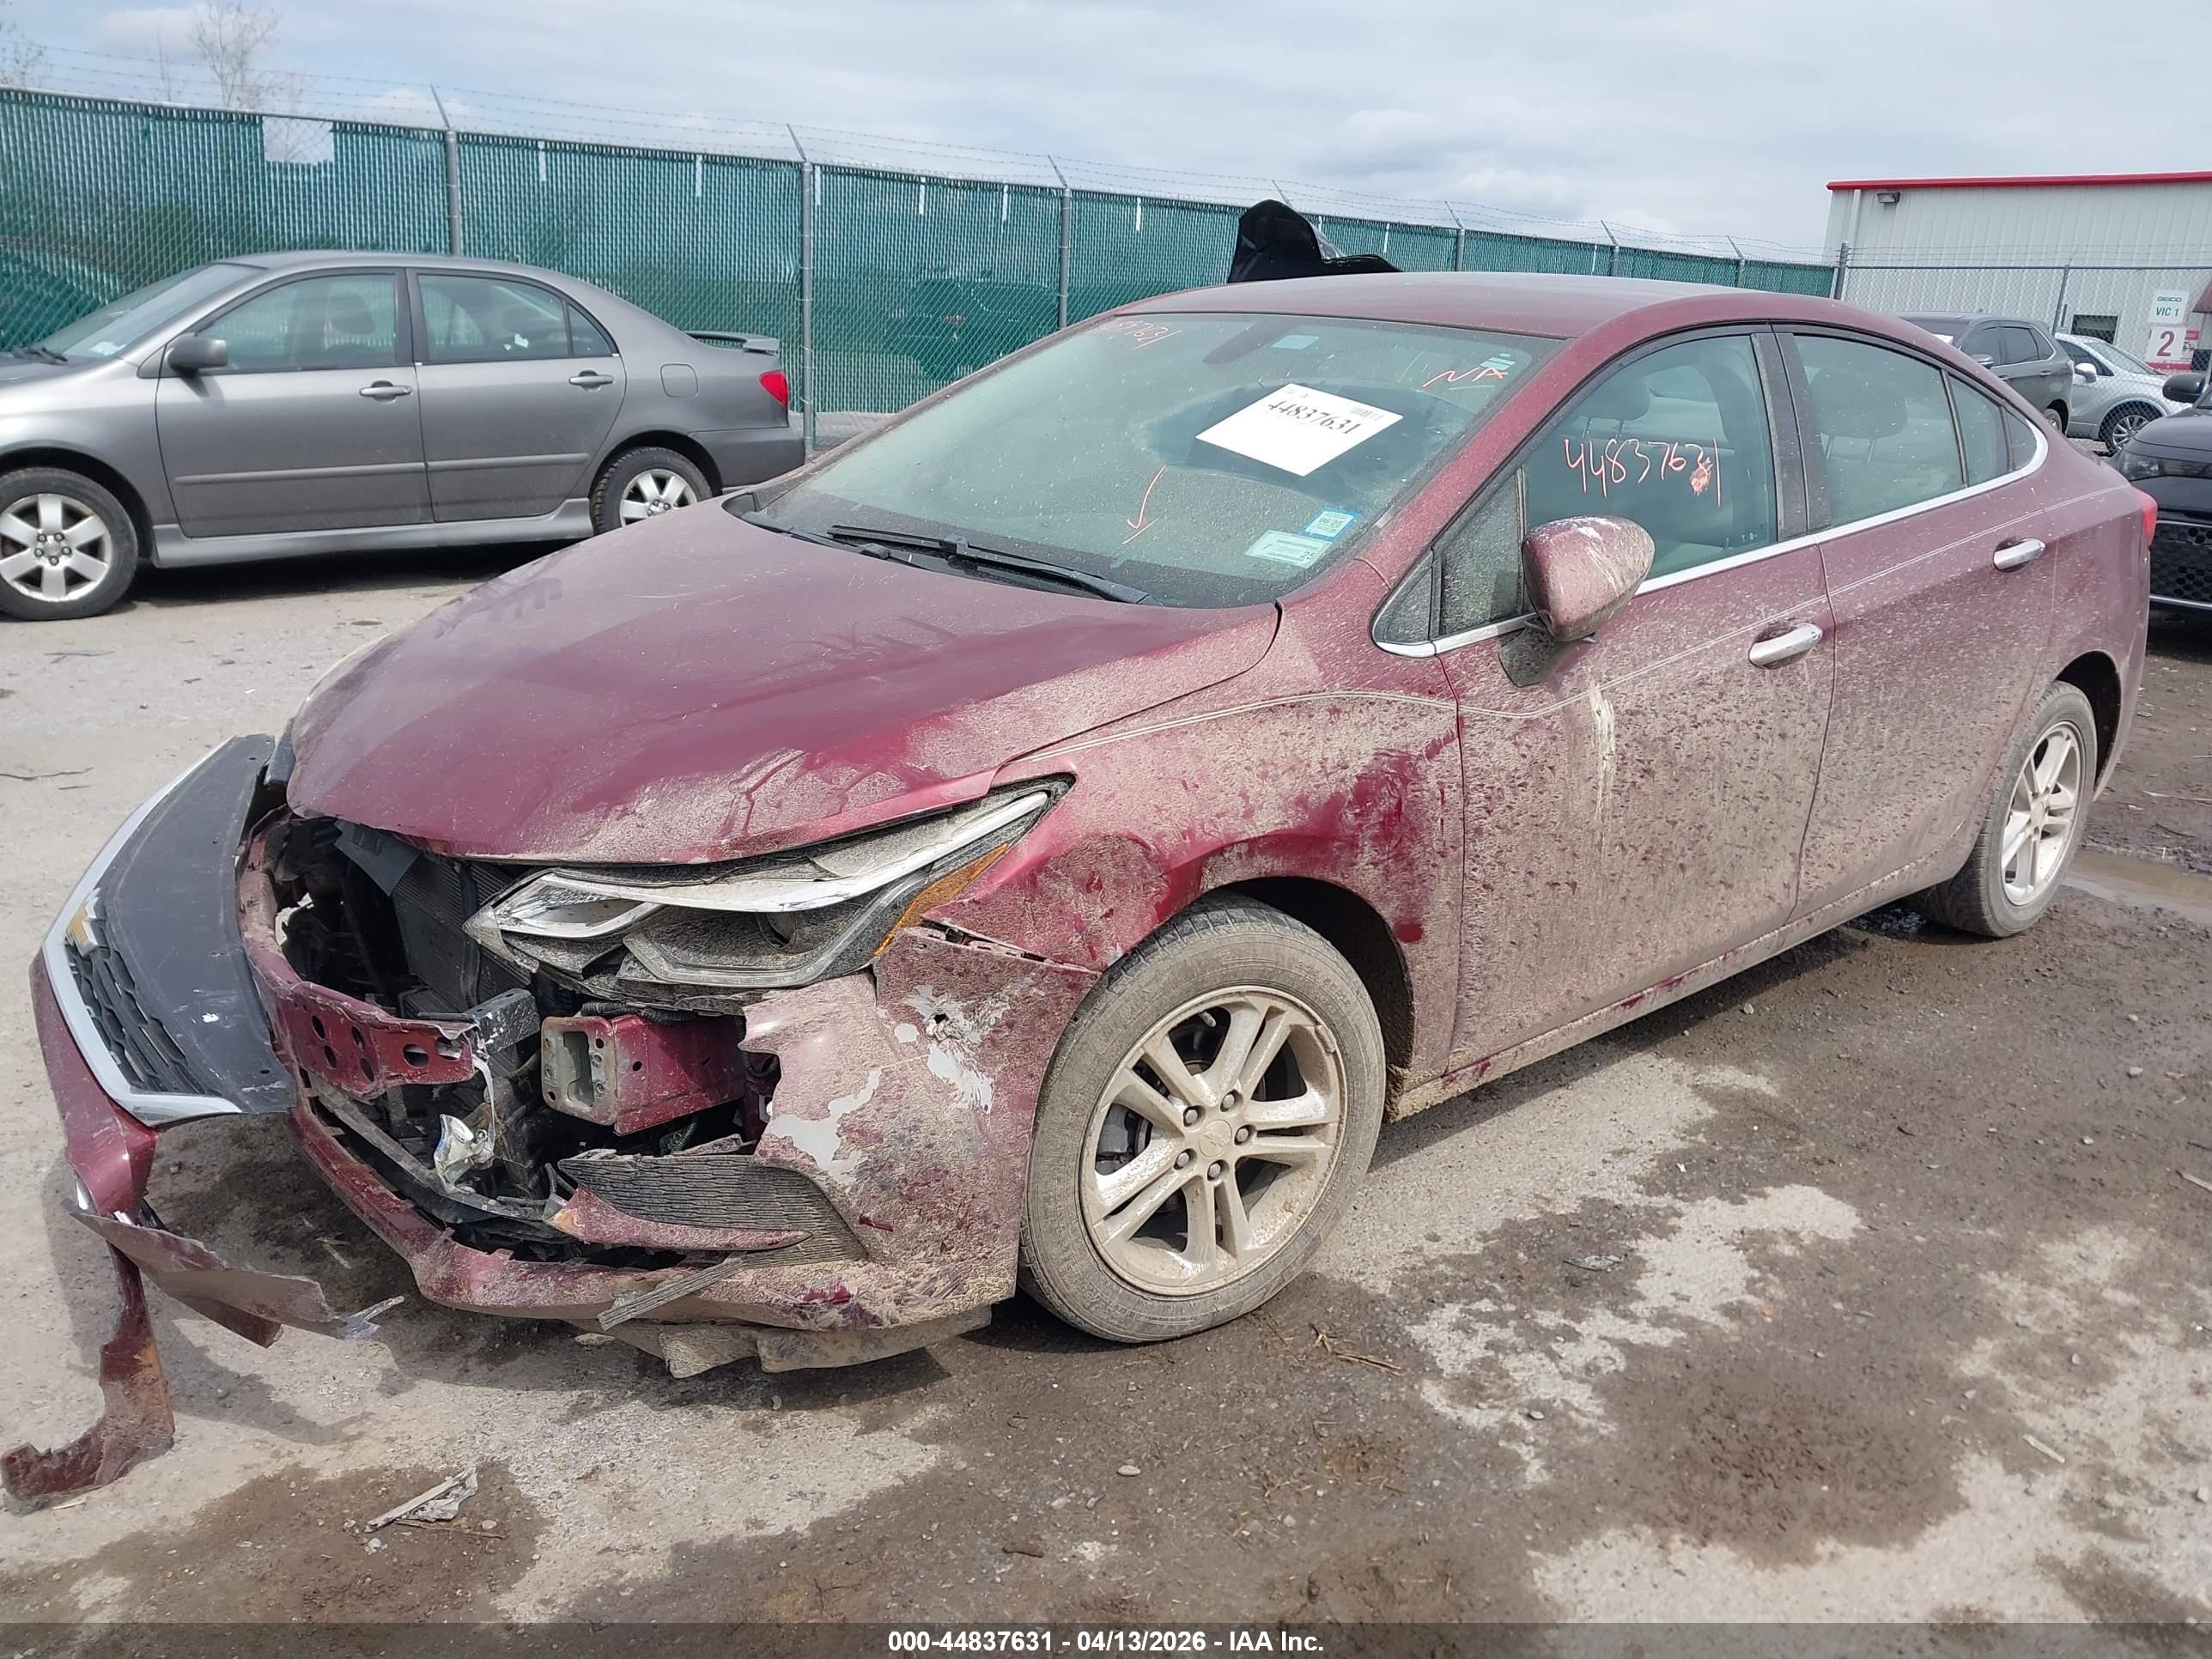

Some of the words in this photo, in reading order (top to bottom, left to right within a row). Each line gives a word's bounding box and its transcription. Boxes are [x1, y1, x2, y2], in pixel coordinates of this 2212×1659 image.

[2156, 307, 2172, 316] VIC
[2156, 330, 2175, 357] 2
[1267, 400, 1362, 434] 44837631
